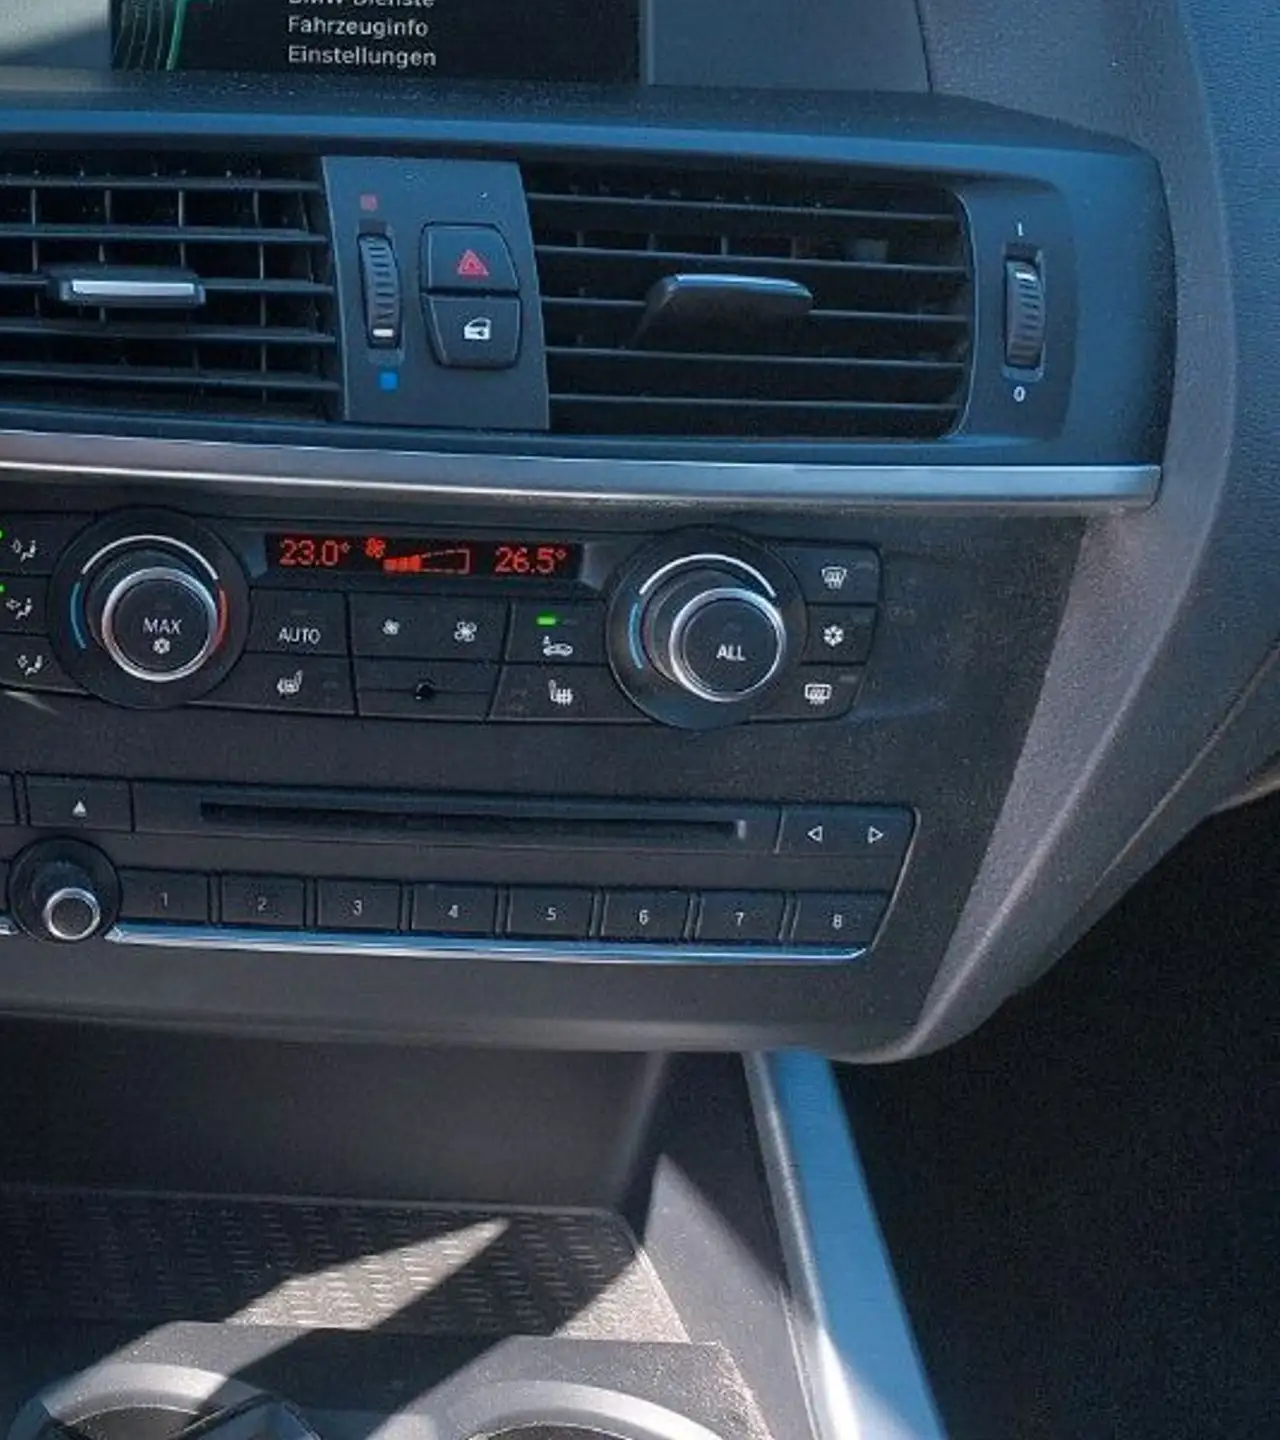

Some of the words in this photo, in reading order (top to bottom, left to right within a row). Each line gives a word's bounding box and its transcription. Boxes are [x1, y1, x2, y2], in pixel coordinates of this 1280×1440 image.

[288, 15, 430, 41] Fahrzeuginfo
[288, 44, 438, 70] Einstellungen
[1012, 386, 1027, 402] 0
[278, 540, 352, 567] 23.0°
[494, 545, 568, 574] 26.5°
[142, 614, 182, 637] MAX
[277, 624, 321, 645] AUTO
[715, 641, 746, 663] ALL
[161, 892, 169, 908] 1
[256, 896, 268, 914] 2
[352, 898, 363, 916] 3
[447, 903, 460, 920] 4
[547, 905, 557, 922] 5
[638, 909, 649, 927] 6
[734, 910, 745, 928] 7
[832, 912, 844, 931] 8
